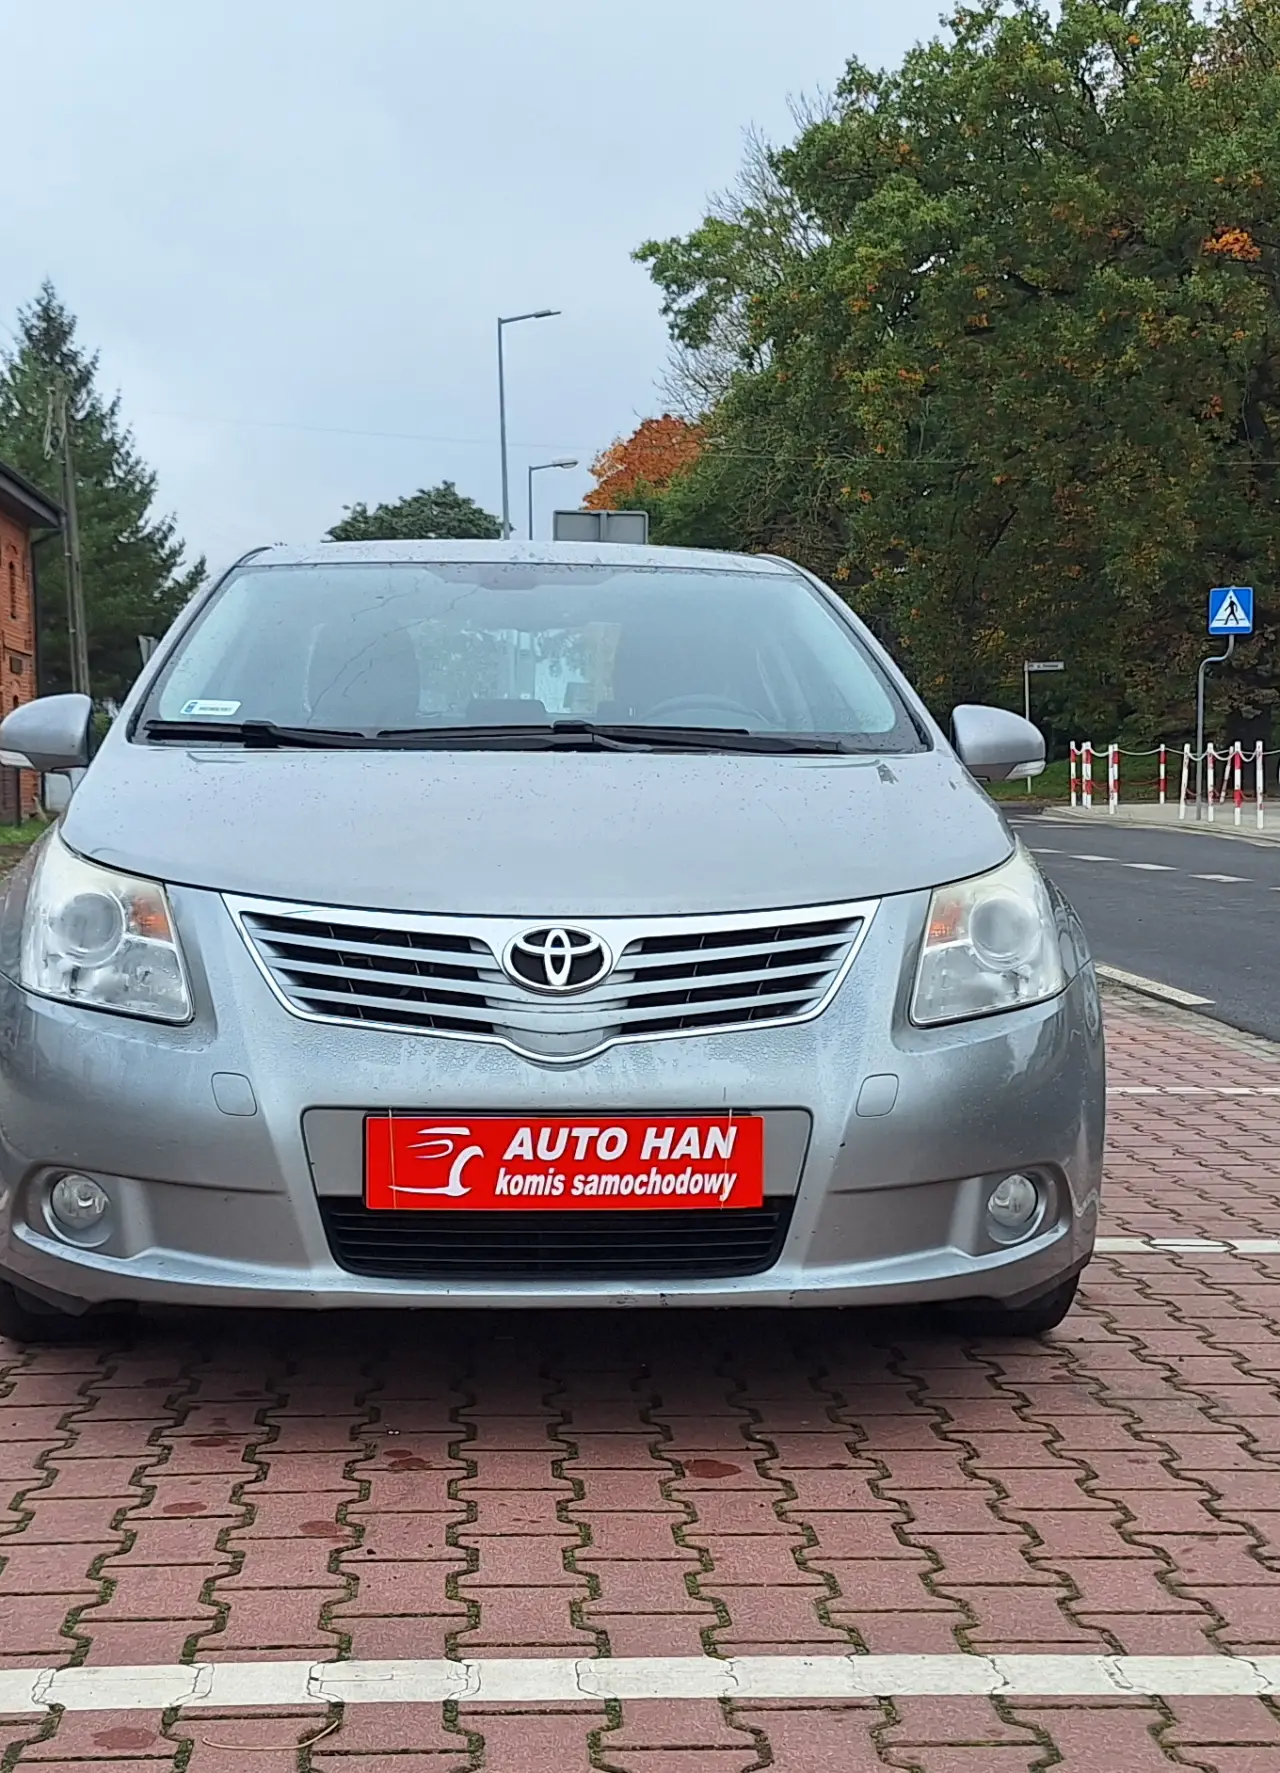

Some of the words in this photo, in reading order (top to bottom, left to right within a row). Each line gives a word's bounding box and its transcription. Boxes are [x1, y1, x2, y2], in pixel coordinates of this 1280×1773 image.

[502, 1125, 627, 1161] AUTO
[640, 1125, 738, 1161] HAN
[495, 1167, 566, 1196] komis
[571, 1166, 738, 1202] samochodowy
